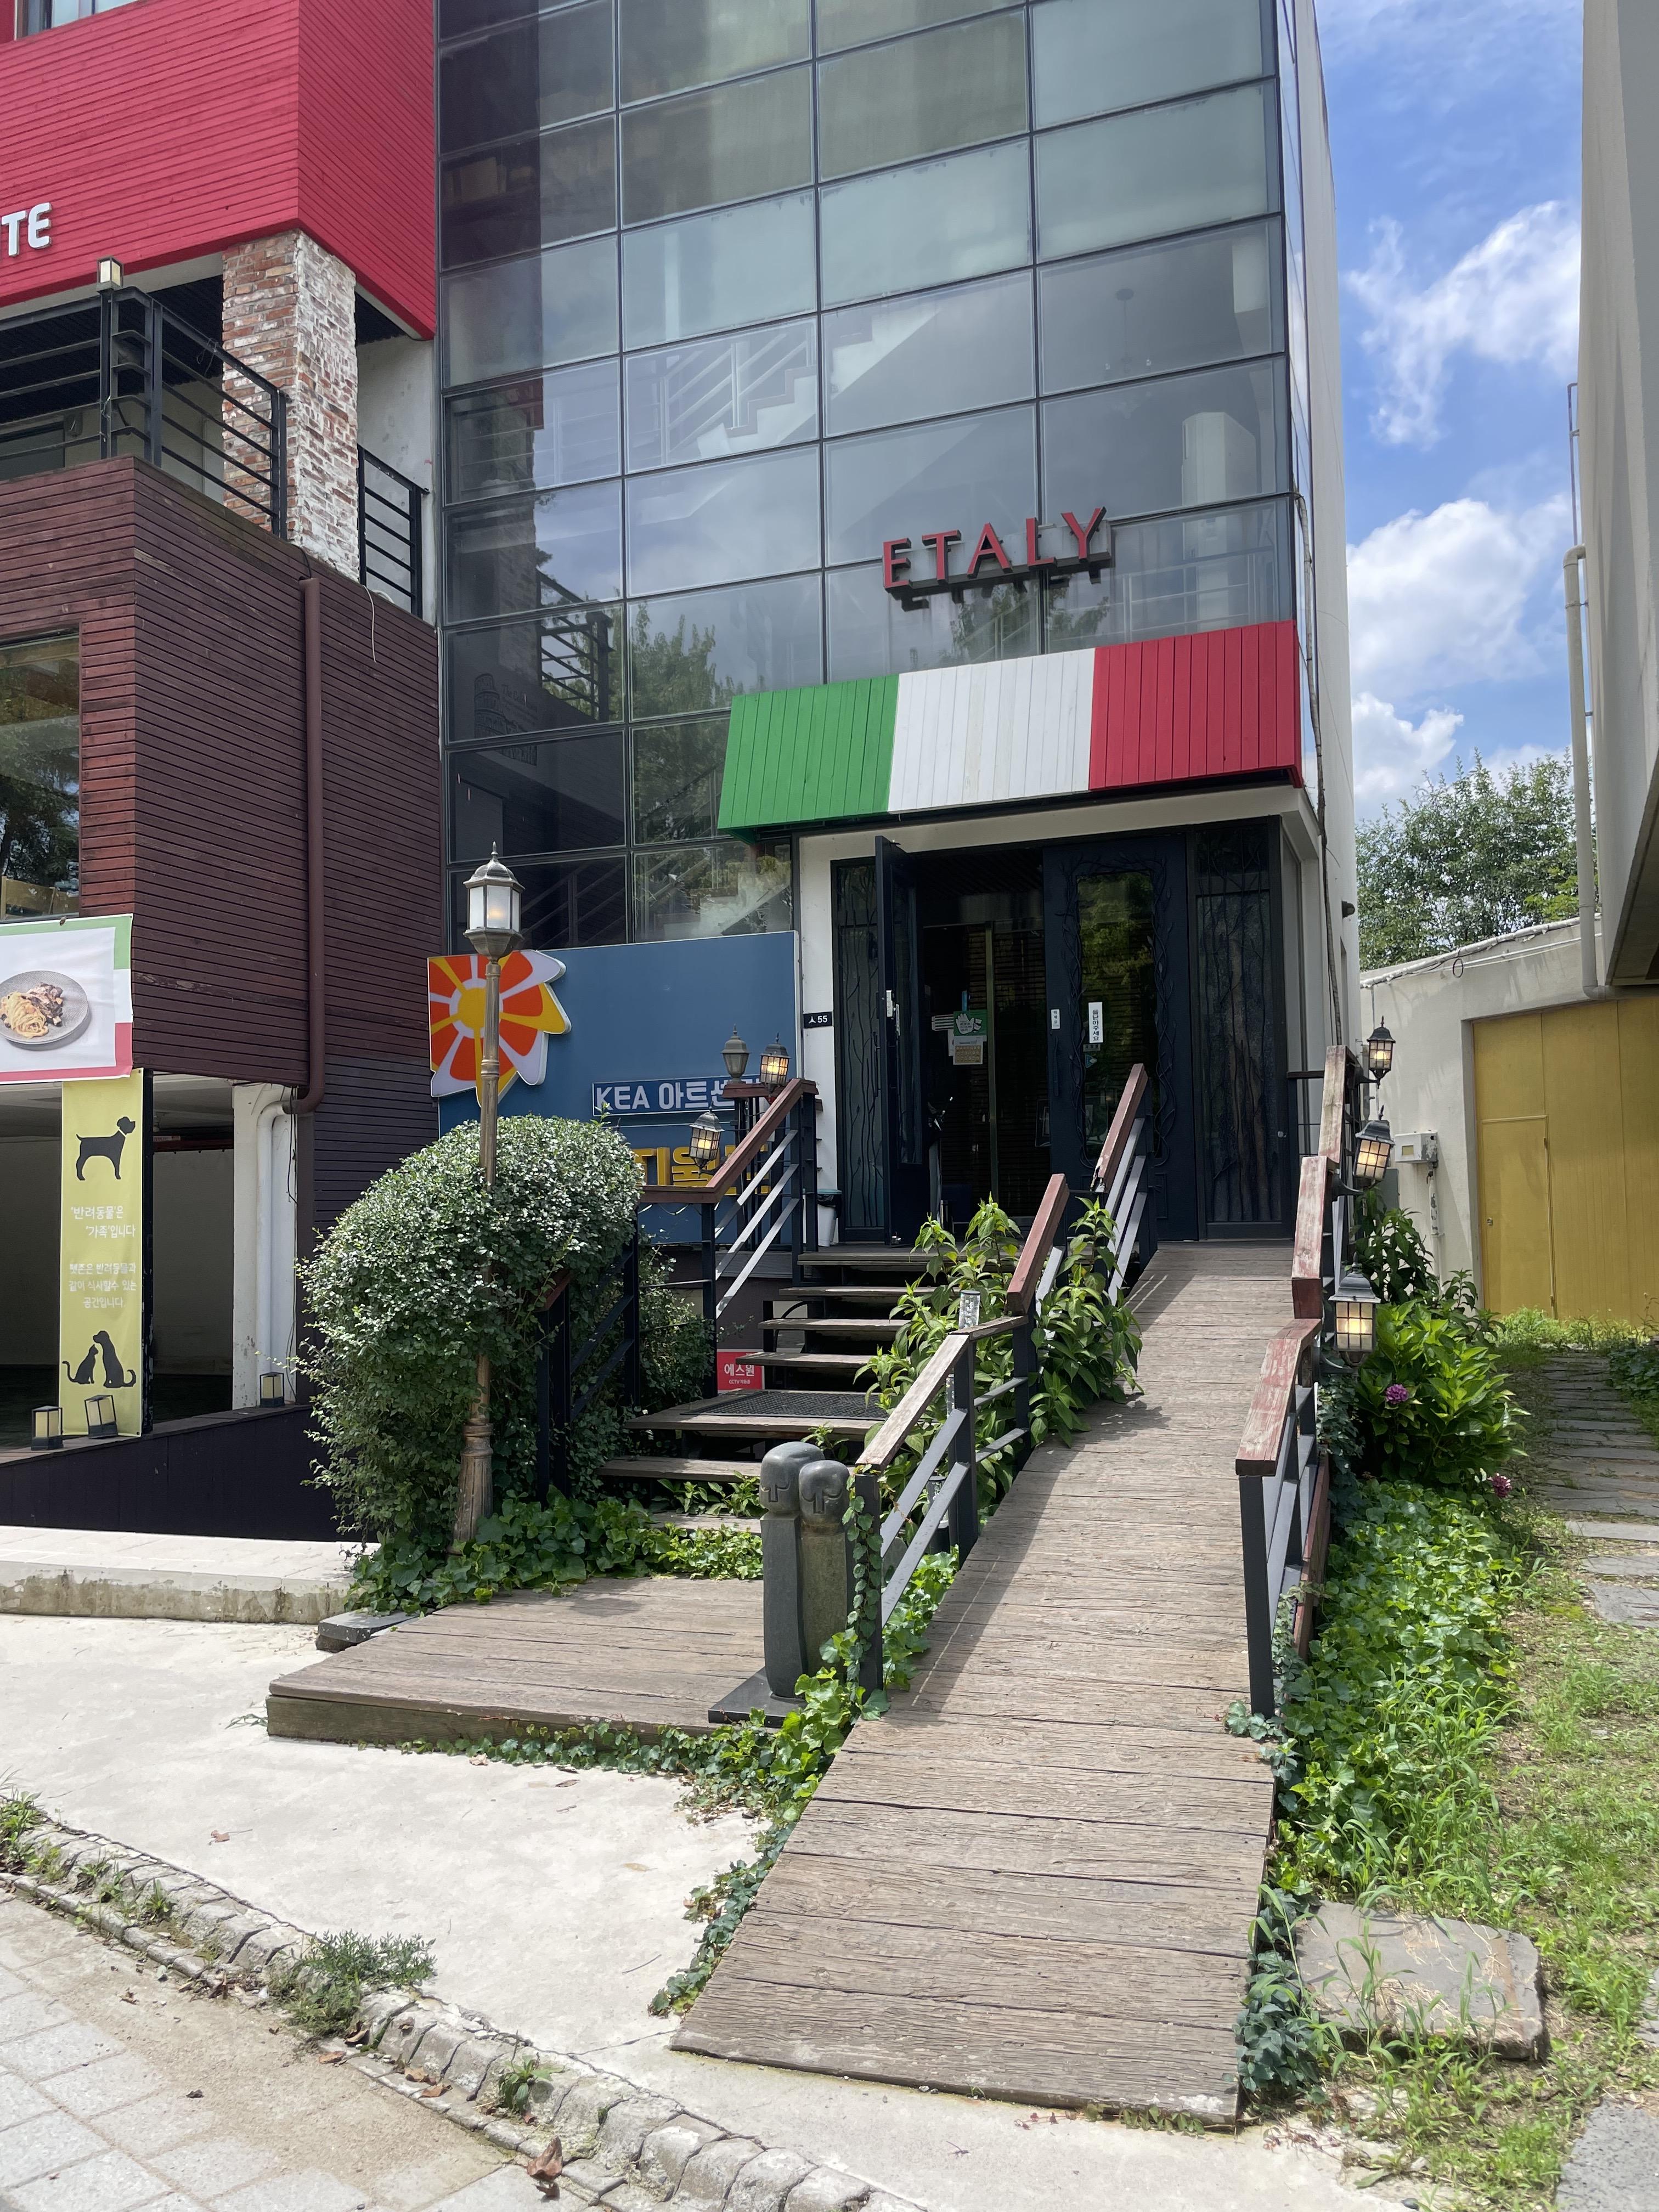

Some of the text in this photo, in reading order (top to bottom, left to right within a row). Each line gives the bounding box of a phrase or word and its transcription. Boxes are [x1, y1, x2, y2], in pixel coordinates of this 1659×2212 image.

[883, 506, 1107, 590] ETALY
[817, 1015, 828, 1023] 55
[596, 1079, 761, 1110] KEA 아트센
[96, 1262, 136, 1274] 반려동물과
[69, 1280, 85, 1291] 같이
[122, 1279, 137, 1291] 있는
[724, 1363, 754, 1376] 에스원
